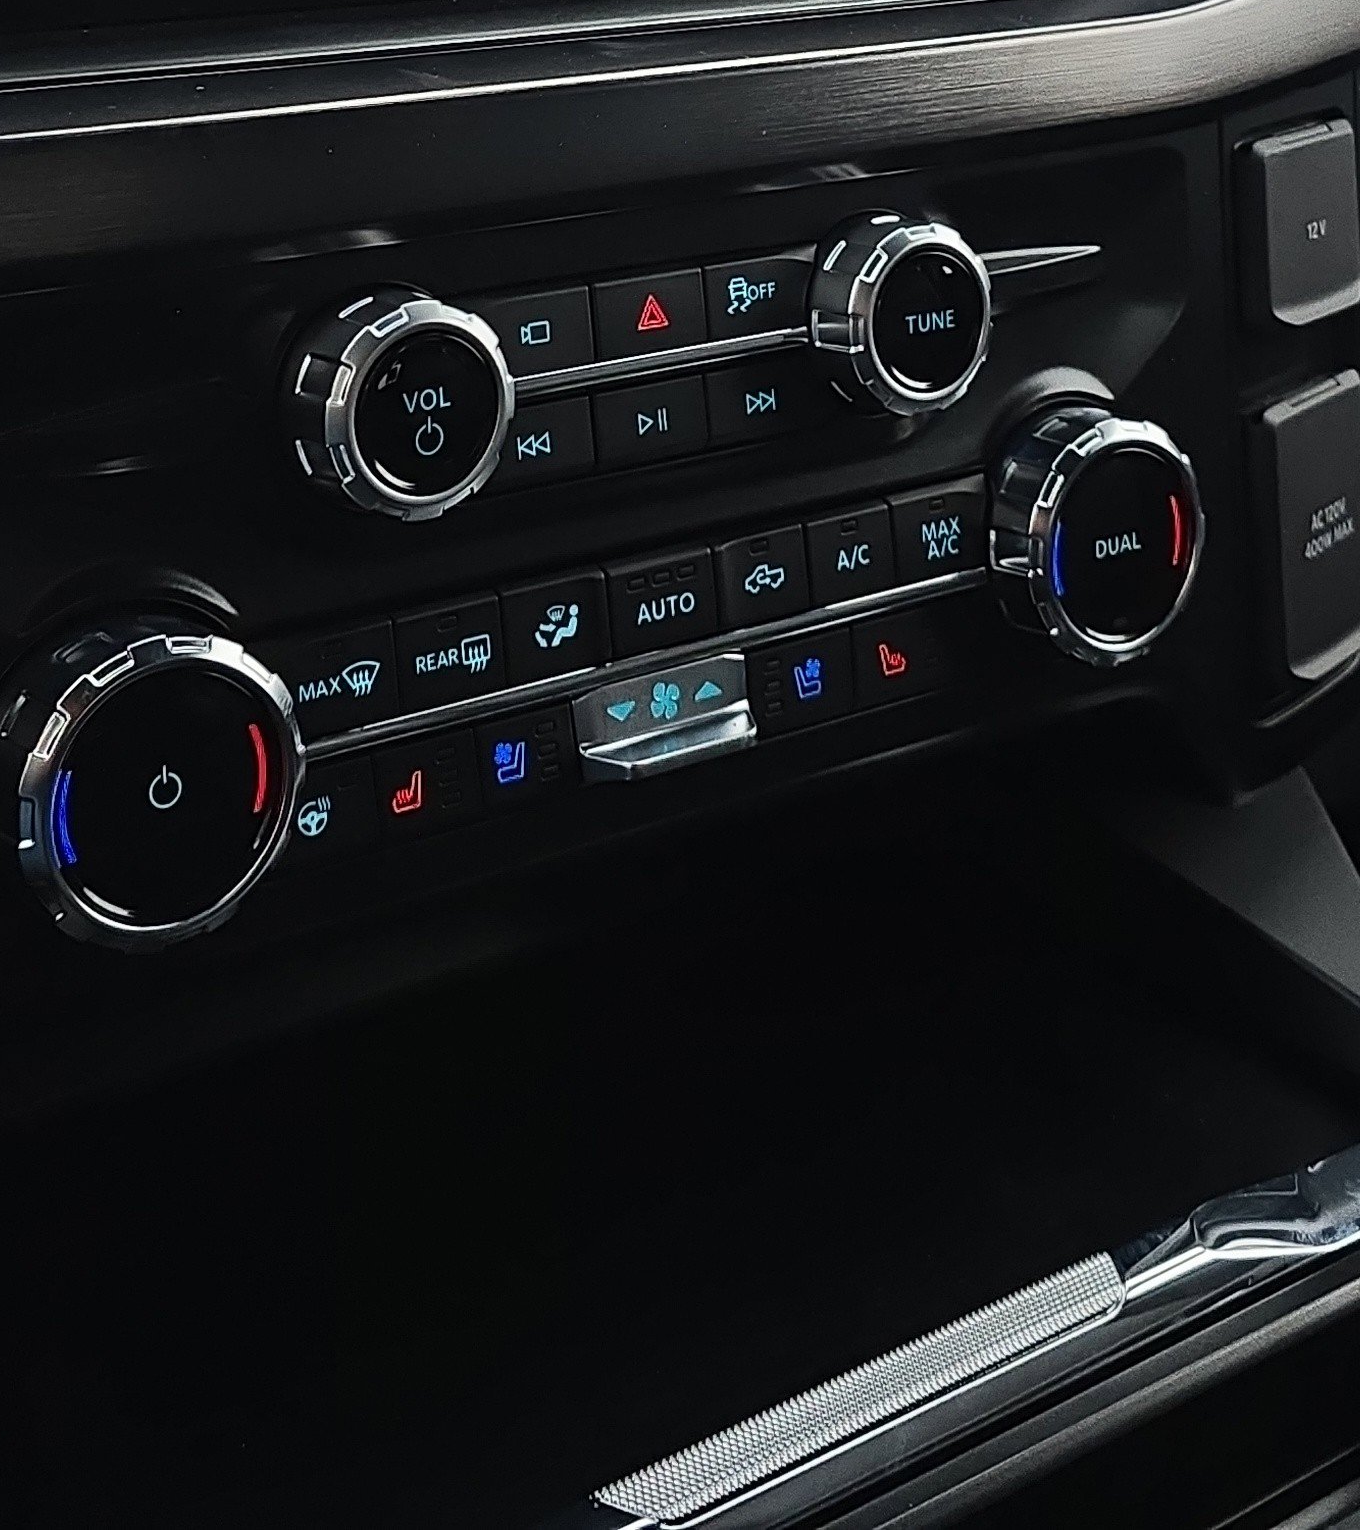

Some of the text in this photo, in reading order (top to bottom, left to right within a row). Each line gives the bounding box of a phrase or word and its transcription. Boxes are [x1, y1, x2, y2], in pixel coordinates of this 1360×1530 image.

[747, 281, 776, 301] OFF
[905, 309, 955, 334] TUNE
[402, 386, 452, 413] VOL
[921, 516, 961, 543] MAX
[1311, 510, 1324, 532] AC
[837, 544, 870, 571] A/C
[926, 535, 960, 561] A/C
[1095, 531, 1142, 559] DUAL
[1305, 530, 1332, 559] 400W
[637, 591, 695, 625] AUTO
[415, 648, 459, 674] REAR
[298, 675, 342, 703] MAX
